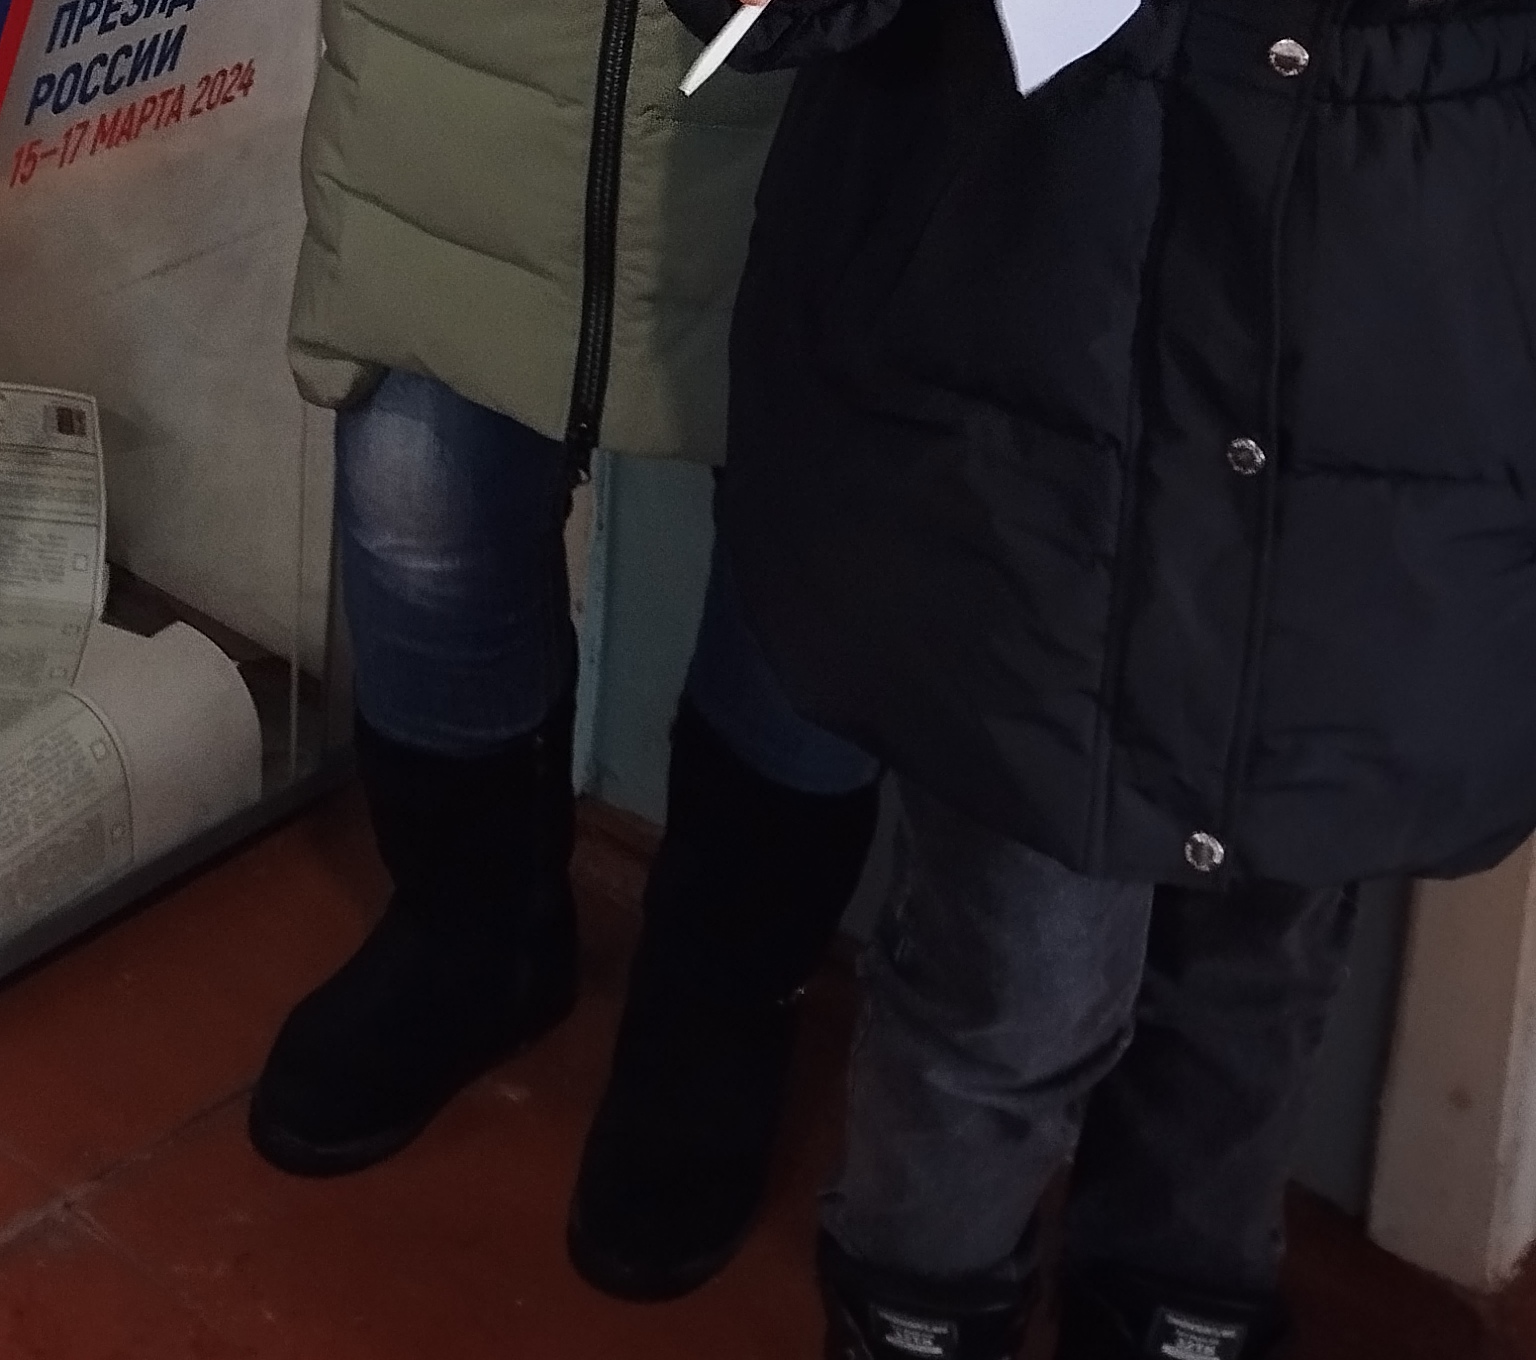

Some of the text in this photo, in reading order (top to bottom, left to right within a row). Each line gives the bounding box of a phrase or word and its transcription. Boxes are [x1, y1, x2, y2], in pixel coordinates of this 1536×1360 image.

[24, 24, 187, 126] РОССИИ
[89, 83, 186, 157] МАРТА
[189, 57, 257, 118] 2024
